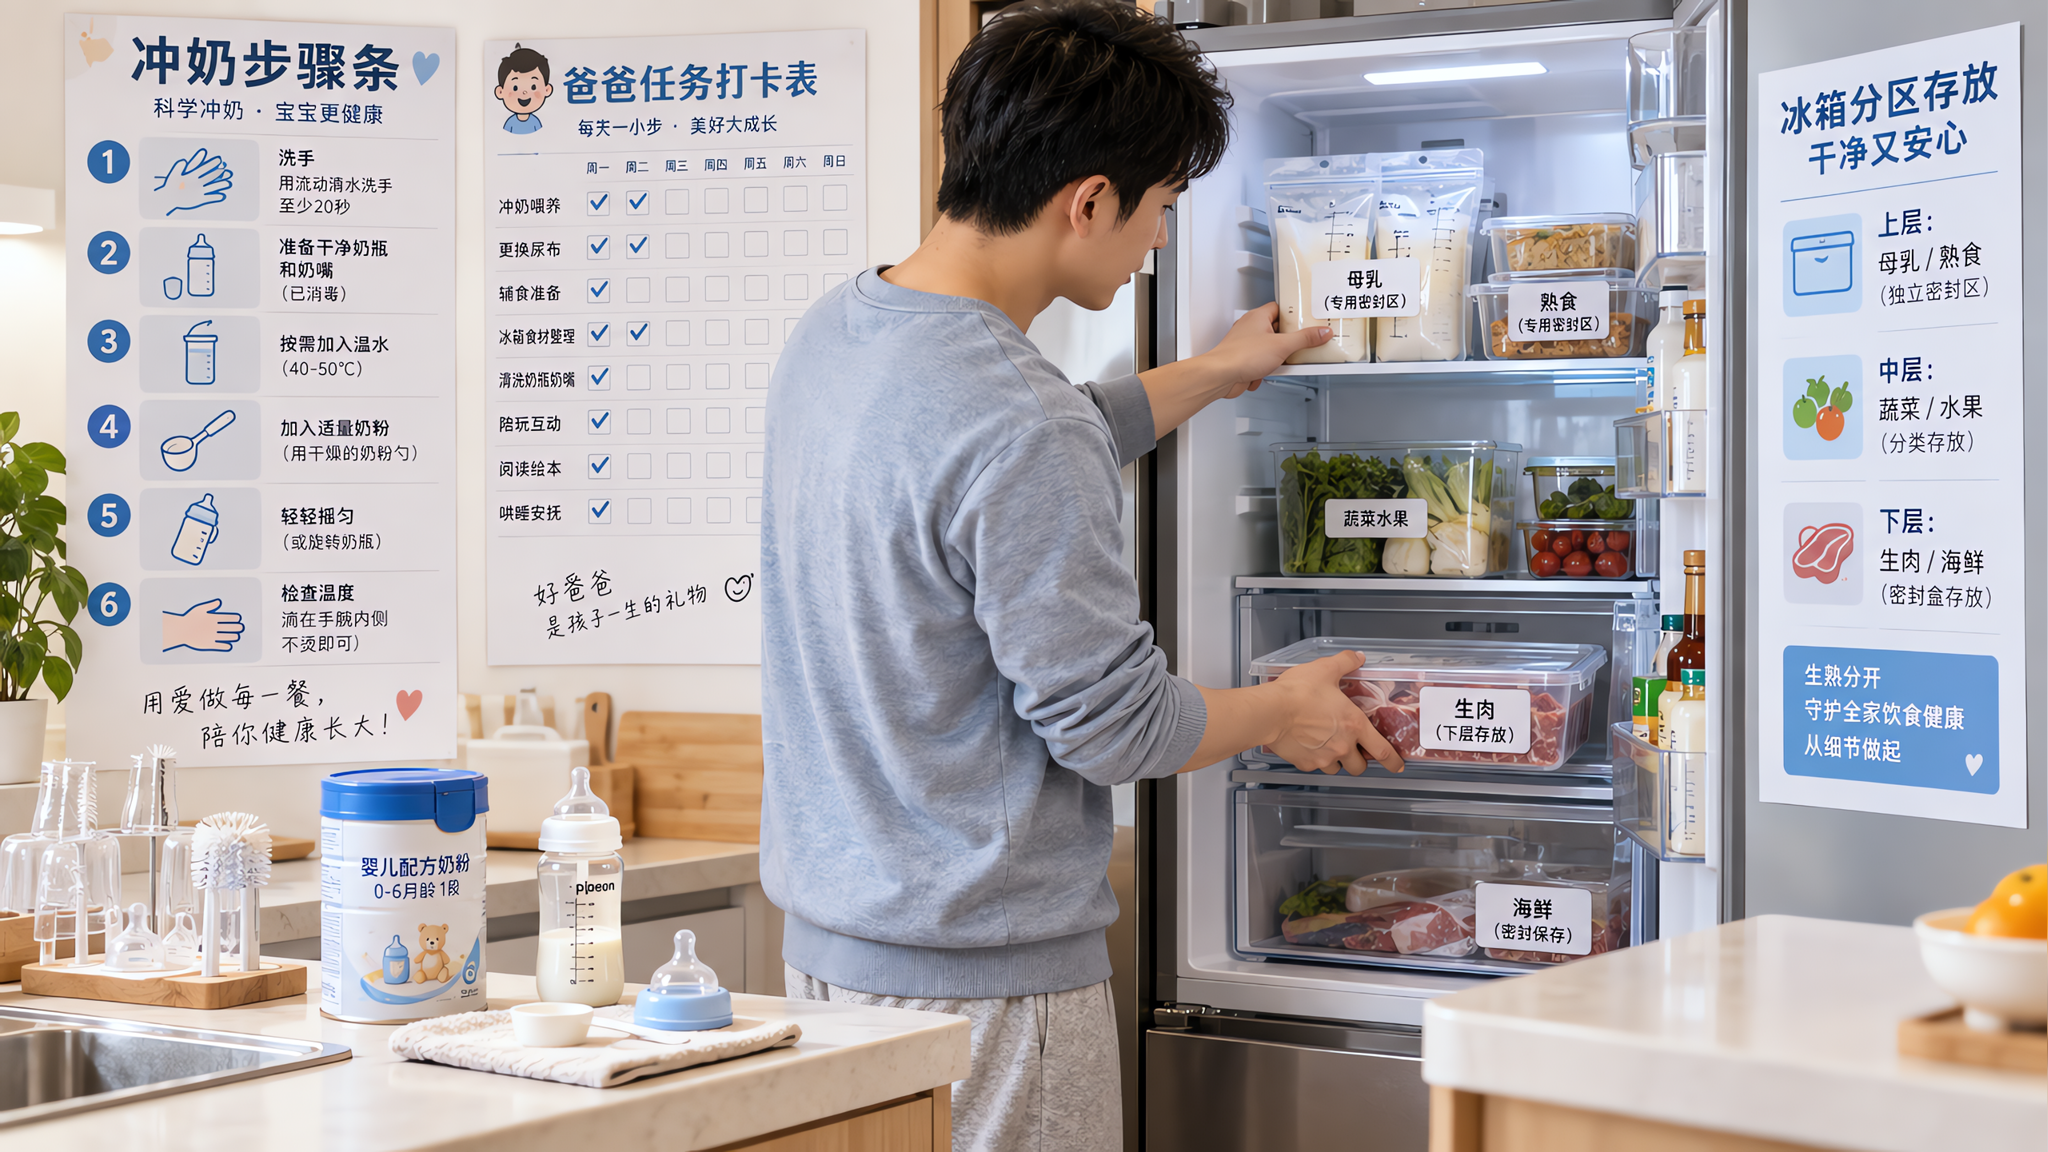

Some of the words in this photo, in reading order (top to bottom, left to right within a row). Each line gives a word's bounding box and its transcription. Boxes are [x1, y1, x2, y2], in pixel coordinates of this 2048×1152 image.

[131, 36, 399, 91] 冲奶步骤条
[563, 60, 817, 104] 爸爸任务打卡表
[1780, 60, 1999, 136] 冰箱分区存放
[154, 98, 243, 120] 科学冲奶
[276, 101, 382, 124] 宝宝更健康
[691, 115, 777, 135] 美好大成长
[279, 149, 314, 167] 洗手
[1808, 120, 1969, 176] 干净又安心
[103, 150, 112, 174] 1
[279, 197, 350, 215] 至少20秒
[101, 240, 117, 265] 2
[280, 238, 388, 257] 准备干净奶瓶
[500, 241, 560, 258] 更换尿布
[1347, 270, 1382, 289] 母乳
[1541, 292, 1577, 312] 熟食
[101, 329, 117, 353] 3
[280, 335, 388, 353] 按需加入温水
[100, 414, 118, 438] 4
[500, 416, 560, 432] 陪玩互动
[101, 503, 117, 528] 5
[1344, 510, 1408, 527] 蔬菜水果
[101, 592, 118, 617] 6
[282, 584, 354, 602] 检查温度
[546, 584, 707, 640] 是孩子一生的礼物
[1805, 663, 1881, 689] 生熟分开
[1455, 698, 1494, 720] 生肉
[1805, 697, 1964, 730] 守护全家饮食健康
[1805, 734, 1900, 762] 从细节做起
[362, 853, 469, 880] 婴儿配方奶粉
[1514, 898, 1552, 920] 海鲜
